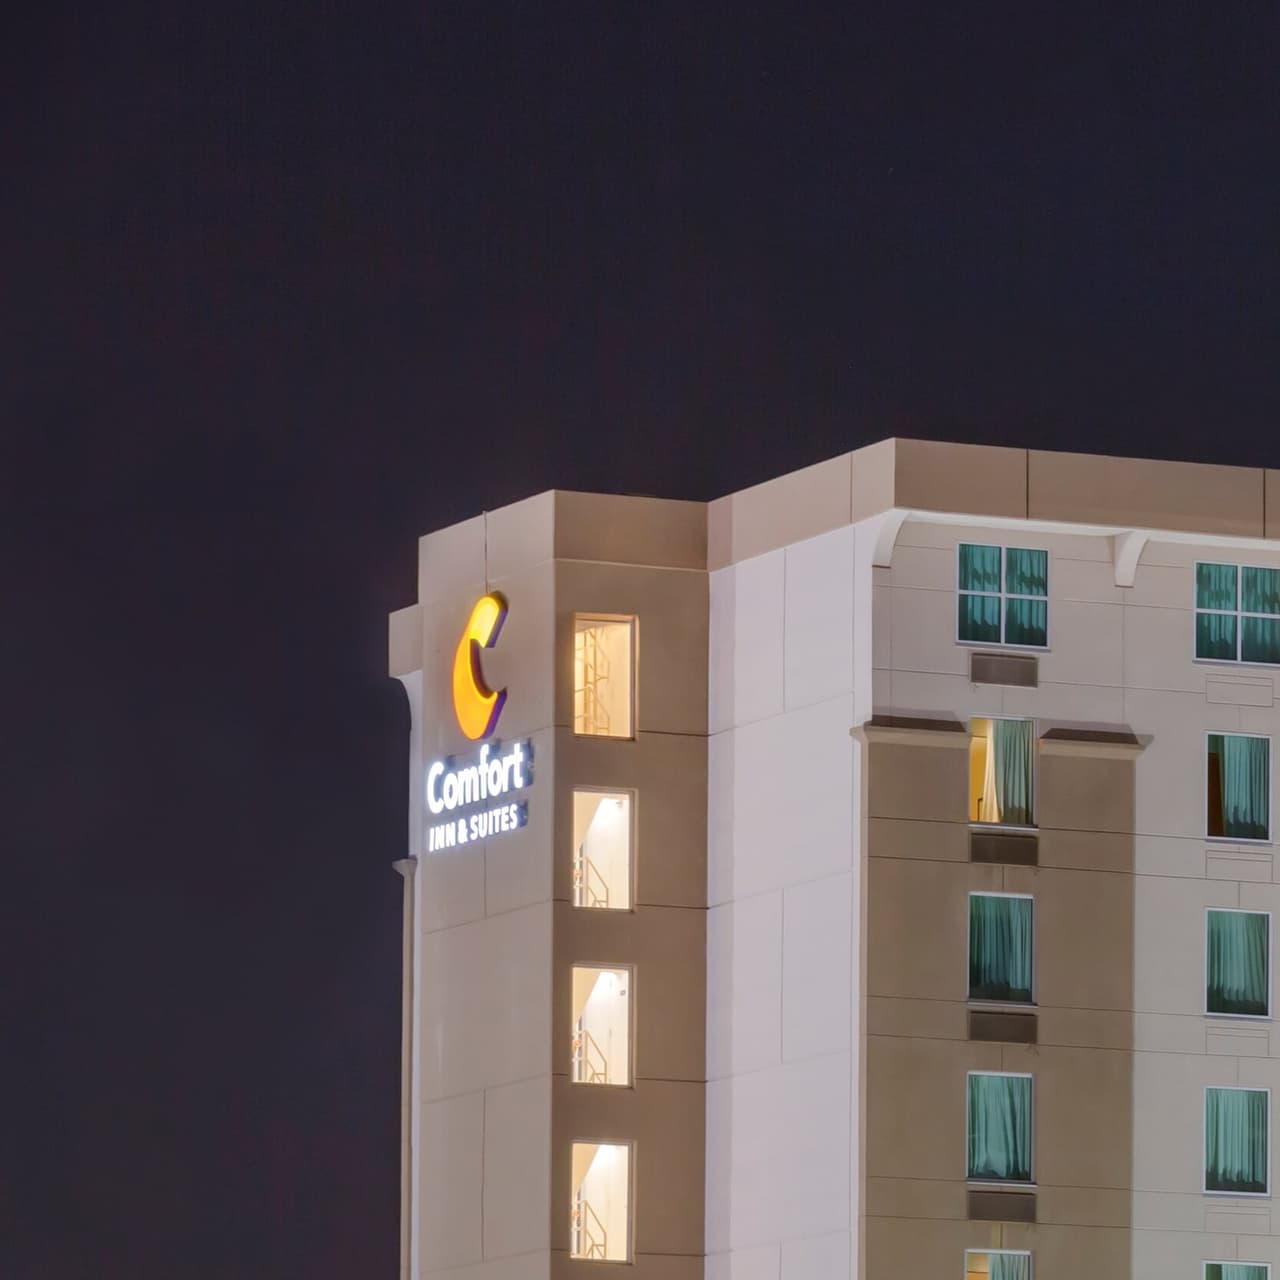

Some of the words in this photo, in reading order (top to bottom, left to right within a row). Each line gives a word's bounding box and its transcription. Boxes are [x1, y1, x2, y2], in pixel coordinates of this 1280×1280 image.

[427, 743, 524, 814] Comfort
[429, 822, 456, 852] INN
[457, 818, 468, 844] &
[469, 803, 518, 841] SUITES
